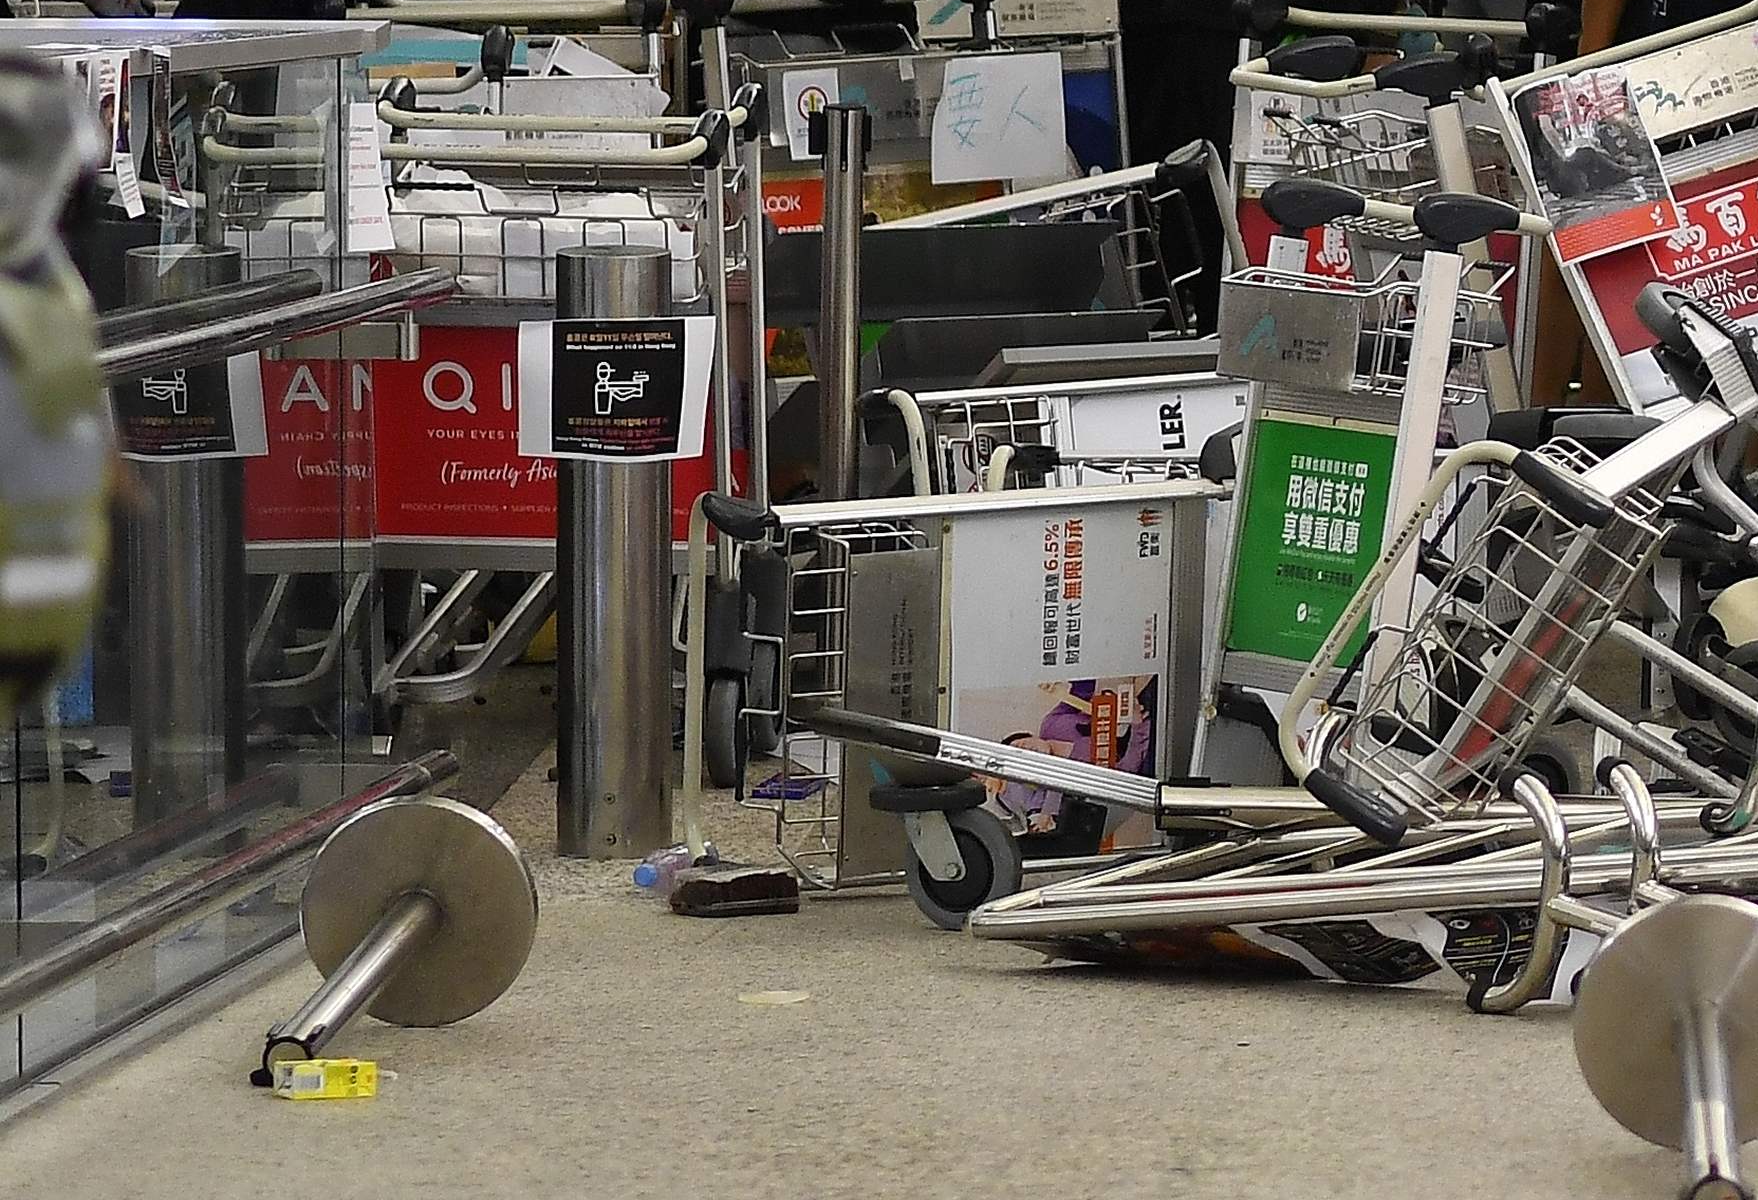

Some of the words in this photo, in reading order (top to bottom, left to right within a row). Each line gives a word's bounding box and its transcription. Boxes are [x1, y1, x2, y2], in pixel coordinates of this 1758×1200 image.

[1673, 254, 1704, 272] MA
[1709, 239, 1743, 259] PAK
[427, 428, 464, 440] YOUR
[470, 429, 505, 440] EYES
[440, 461, 522, 488] (Formerly
[1286, 474, 1366, 517] 用微信支付
[1138, 531, 1149, 558] FWD
[1281, 511, 1361, 554] 享雙重優惠
[1063, 518, 1083, 600] 無限傳承
[1064, 602, 1081, 665] 財富世代
